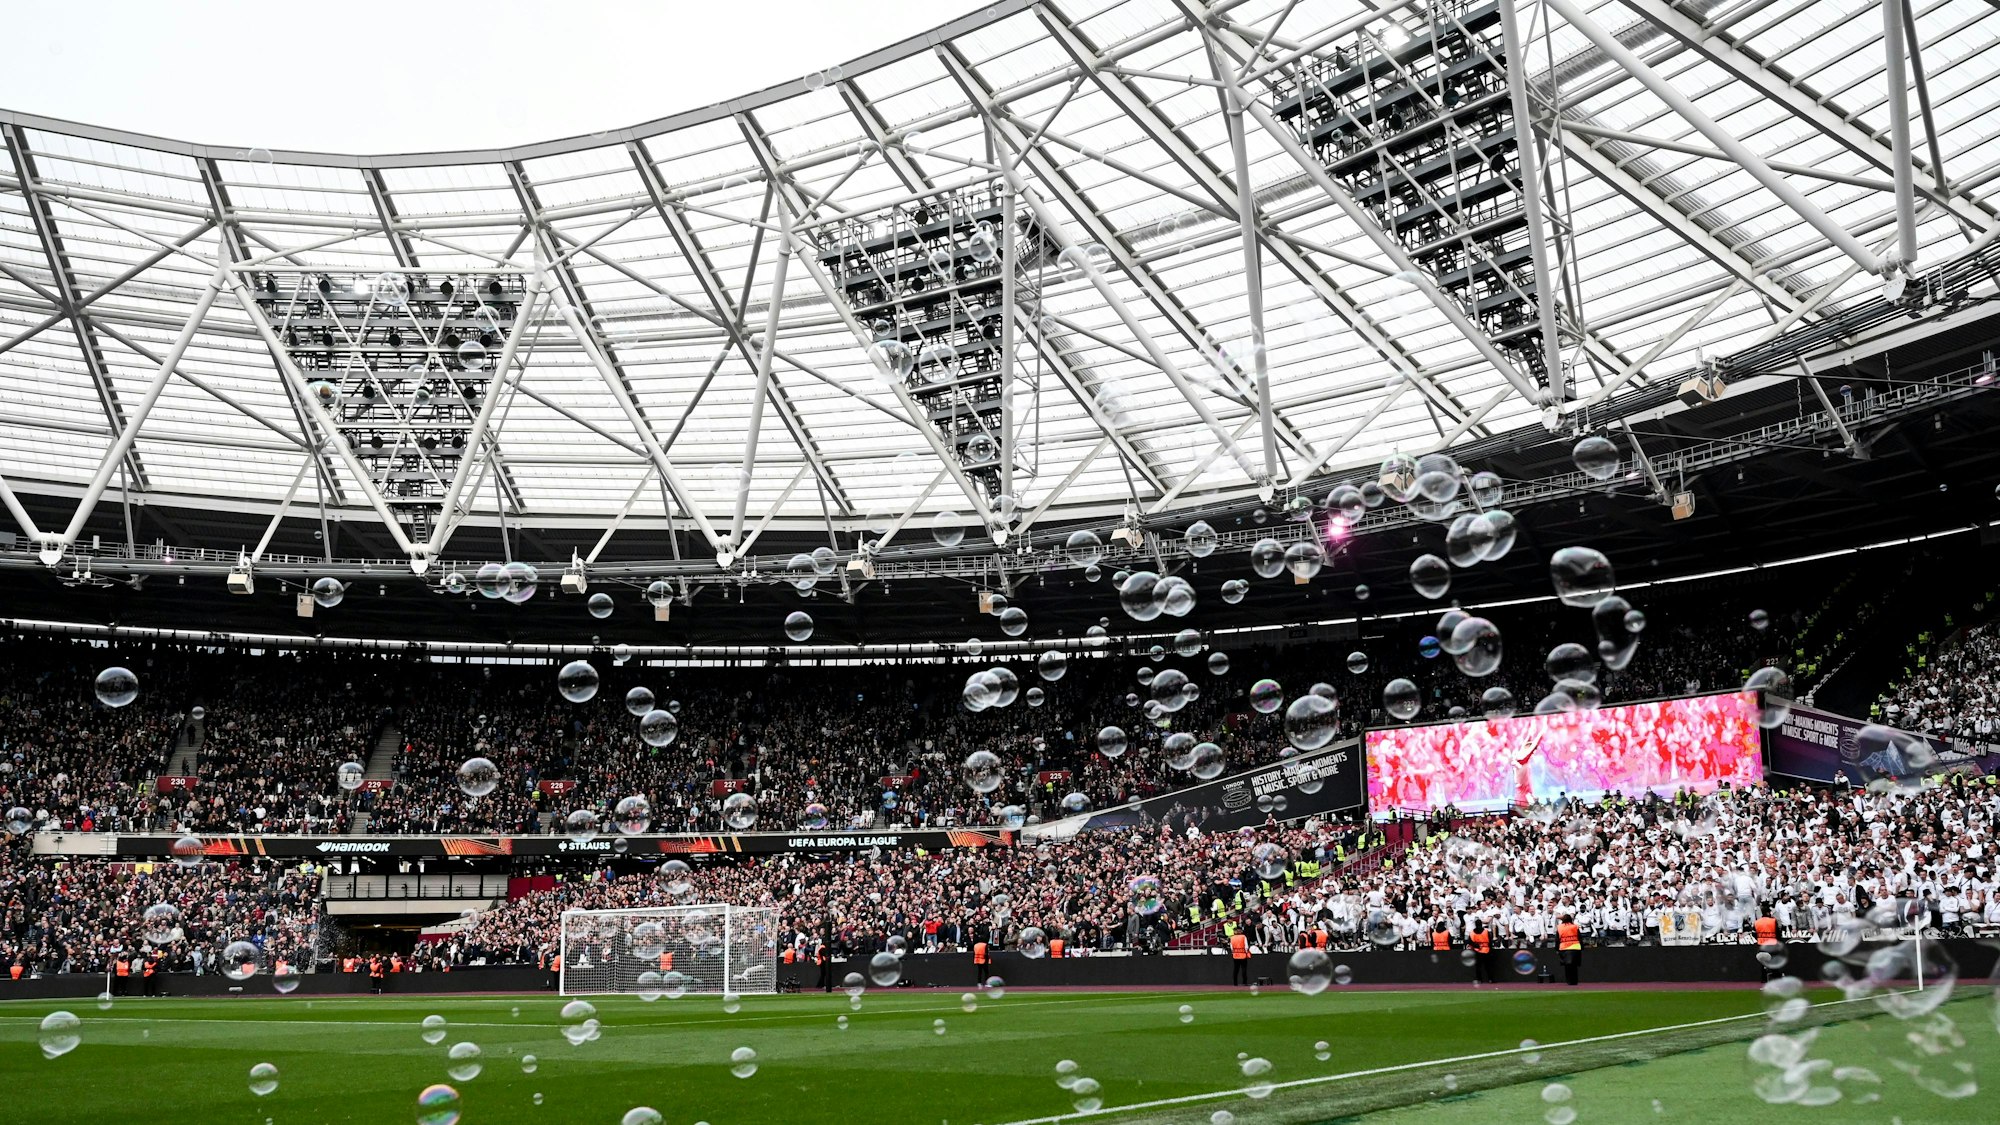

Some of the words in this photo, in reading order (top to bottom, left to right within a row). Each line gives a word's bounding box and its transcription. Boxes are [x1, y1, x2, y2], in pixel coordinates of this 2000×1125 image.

[1781, 723, 1787, 736] IN
[1787, 725, 1803, 742] MUSIC,
[1803, 729, 1820, 744] SPORT
[1819, 733, 1824, 745] &
[1823, 734, 1839, 749] MORE
[1813, 719, 1839, 736] MOMENTS
[1251, 760, 1313, 787] HISTORY-MAKING
[1311, 751, 1347, 770] MOMENTS
[1222, 780, 1245, 790] LONDON
[1253, 786, 1263, 797] IN
[1262, 778, 1289, 795] MUSIC,
[1287, 772, 1311, 787] SPORT
[1311, 770, 1318, 780] &
[1318, 764, 1340, 778] MORE
[568, 841, 611, 851] STRAUSS
[788, 838, 815, 847] UEFA
[817, 837, 856, 847] EUROPA
[858, 836, 898, 846] LEAGUE
